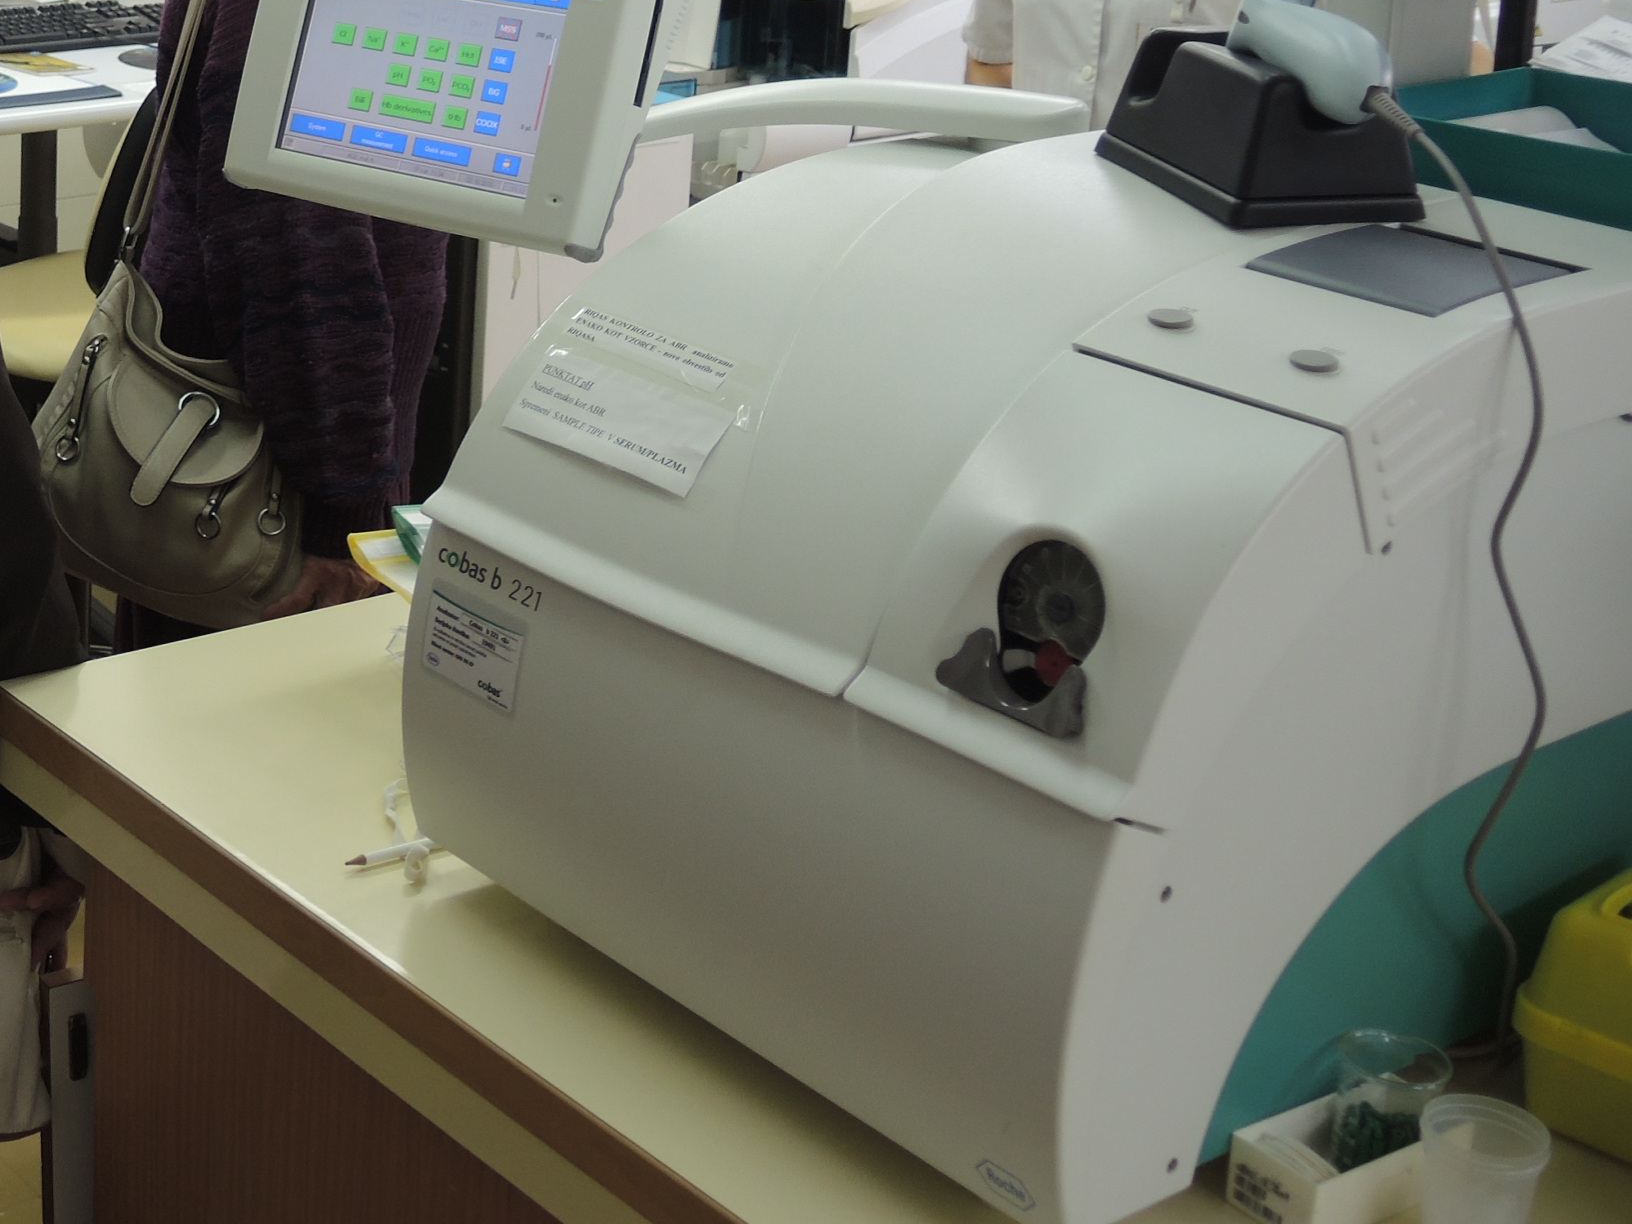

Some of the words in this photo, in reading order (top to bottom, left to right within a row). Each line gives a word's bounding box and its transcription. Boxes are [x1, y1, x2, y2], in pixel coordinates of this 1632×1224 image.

[494, 55, 508, 66] ISE
[488, 87, 501, 98] BG
[393, 103, 432, 117] derivatives
[476, 117, 498, 130] COOX
[424, 145, 440, 155] Quick
[575, 317, 604, 332] ENAKO
[604, 327, 624, 339] KOT
[624, 335, 658, 352] VZORCE
[583, 308, 610, 323] RIQAS
[609, 317, 655, 339] KONTROLO
[655, 335, 667, 345] ZA
[669, 341, 688, 352] ABR
[542, 363, 582, 386] PUNKTAT
[578, 379, 596, 393] pH
[531, 380, 555, 397] Naredi
[554, 390, 575, 405] enako
[574, 397, 587, 410] kot
[586, 404, 607, 418] ABR
[520, 397, 551, 417] Spremeni
[552, 411, 588, 431] SAMPLE
[586, 424, 606, 438] TIPE
[607, 433, 615, 442] V
[614, 437, 688, 475] SERUM/PLAZMA
[438, 547, 488, 584] cobas
[490, 567, 502, 590] b
[508, 579, 543, 612] 221
[986, 1167, 1026, 1203] Roche
